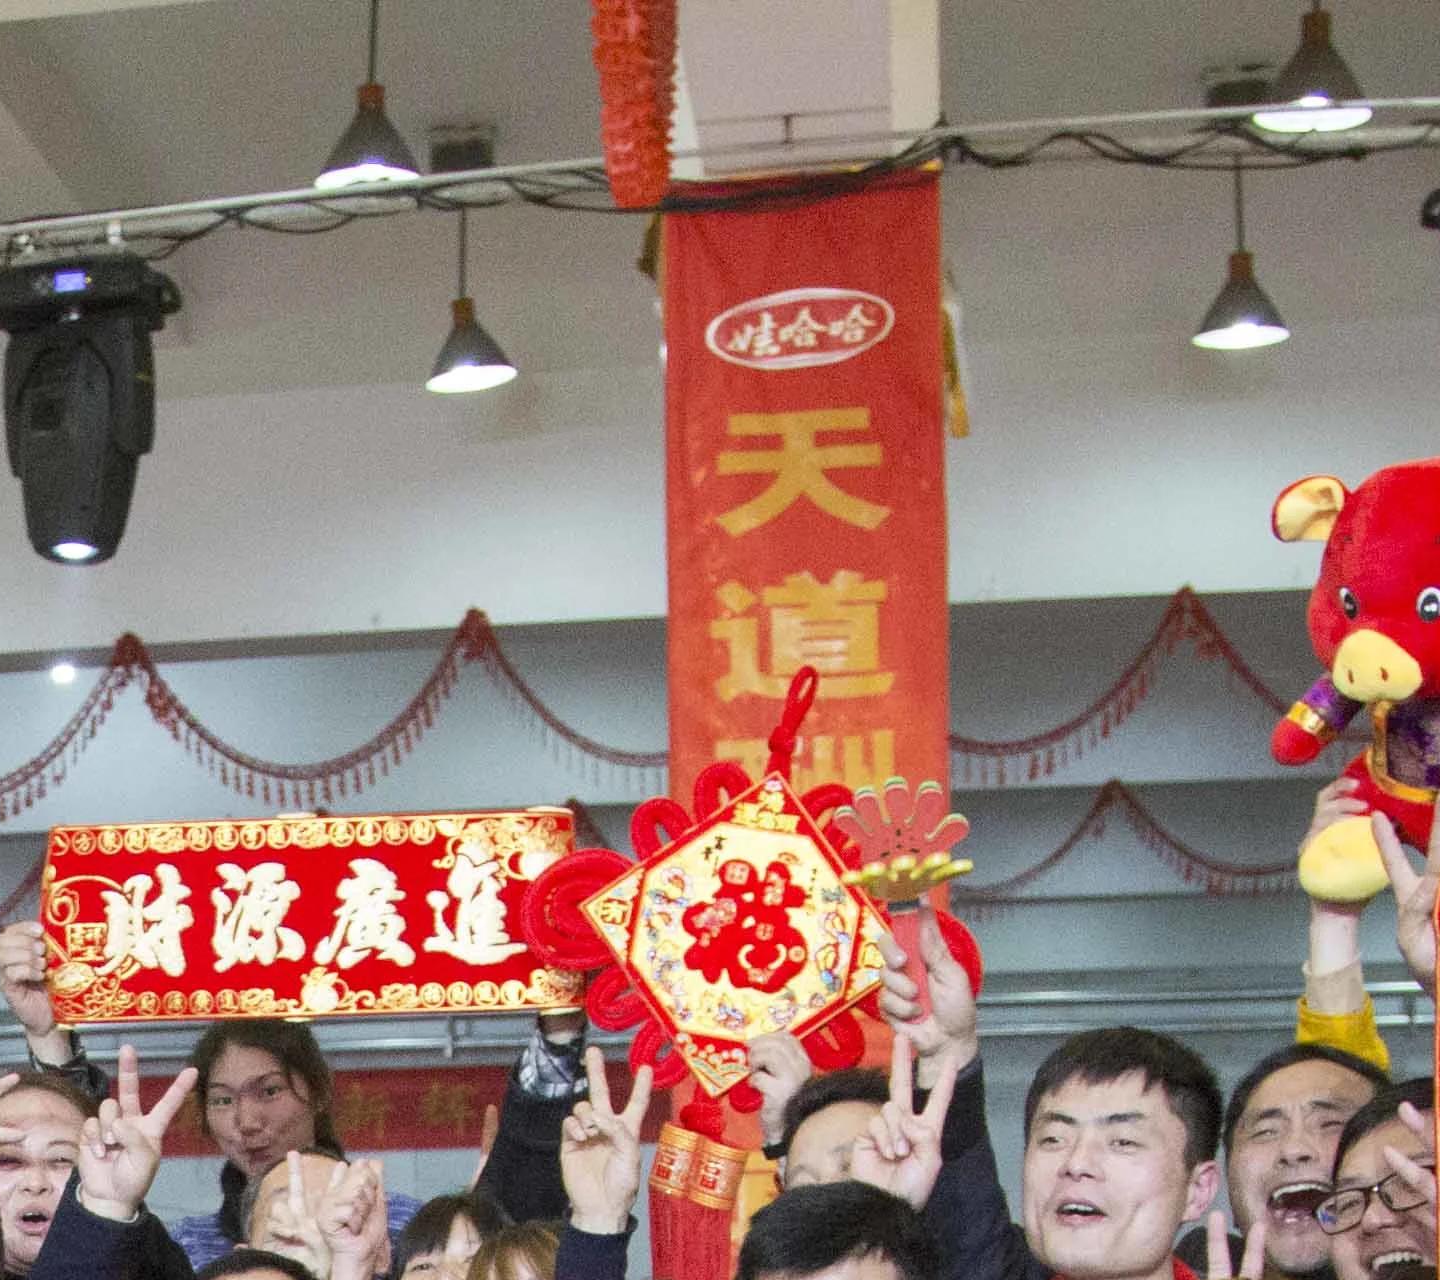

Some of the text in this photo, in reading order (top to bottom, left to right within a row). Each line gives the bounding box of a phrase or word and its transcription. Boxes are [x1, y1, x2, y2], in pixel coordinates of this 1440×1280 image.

[728, 304, 877, 356] 娃哈哈
[94, 854, 528, 978] 財源廣進
